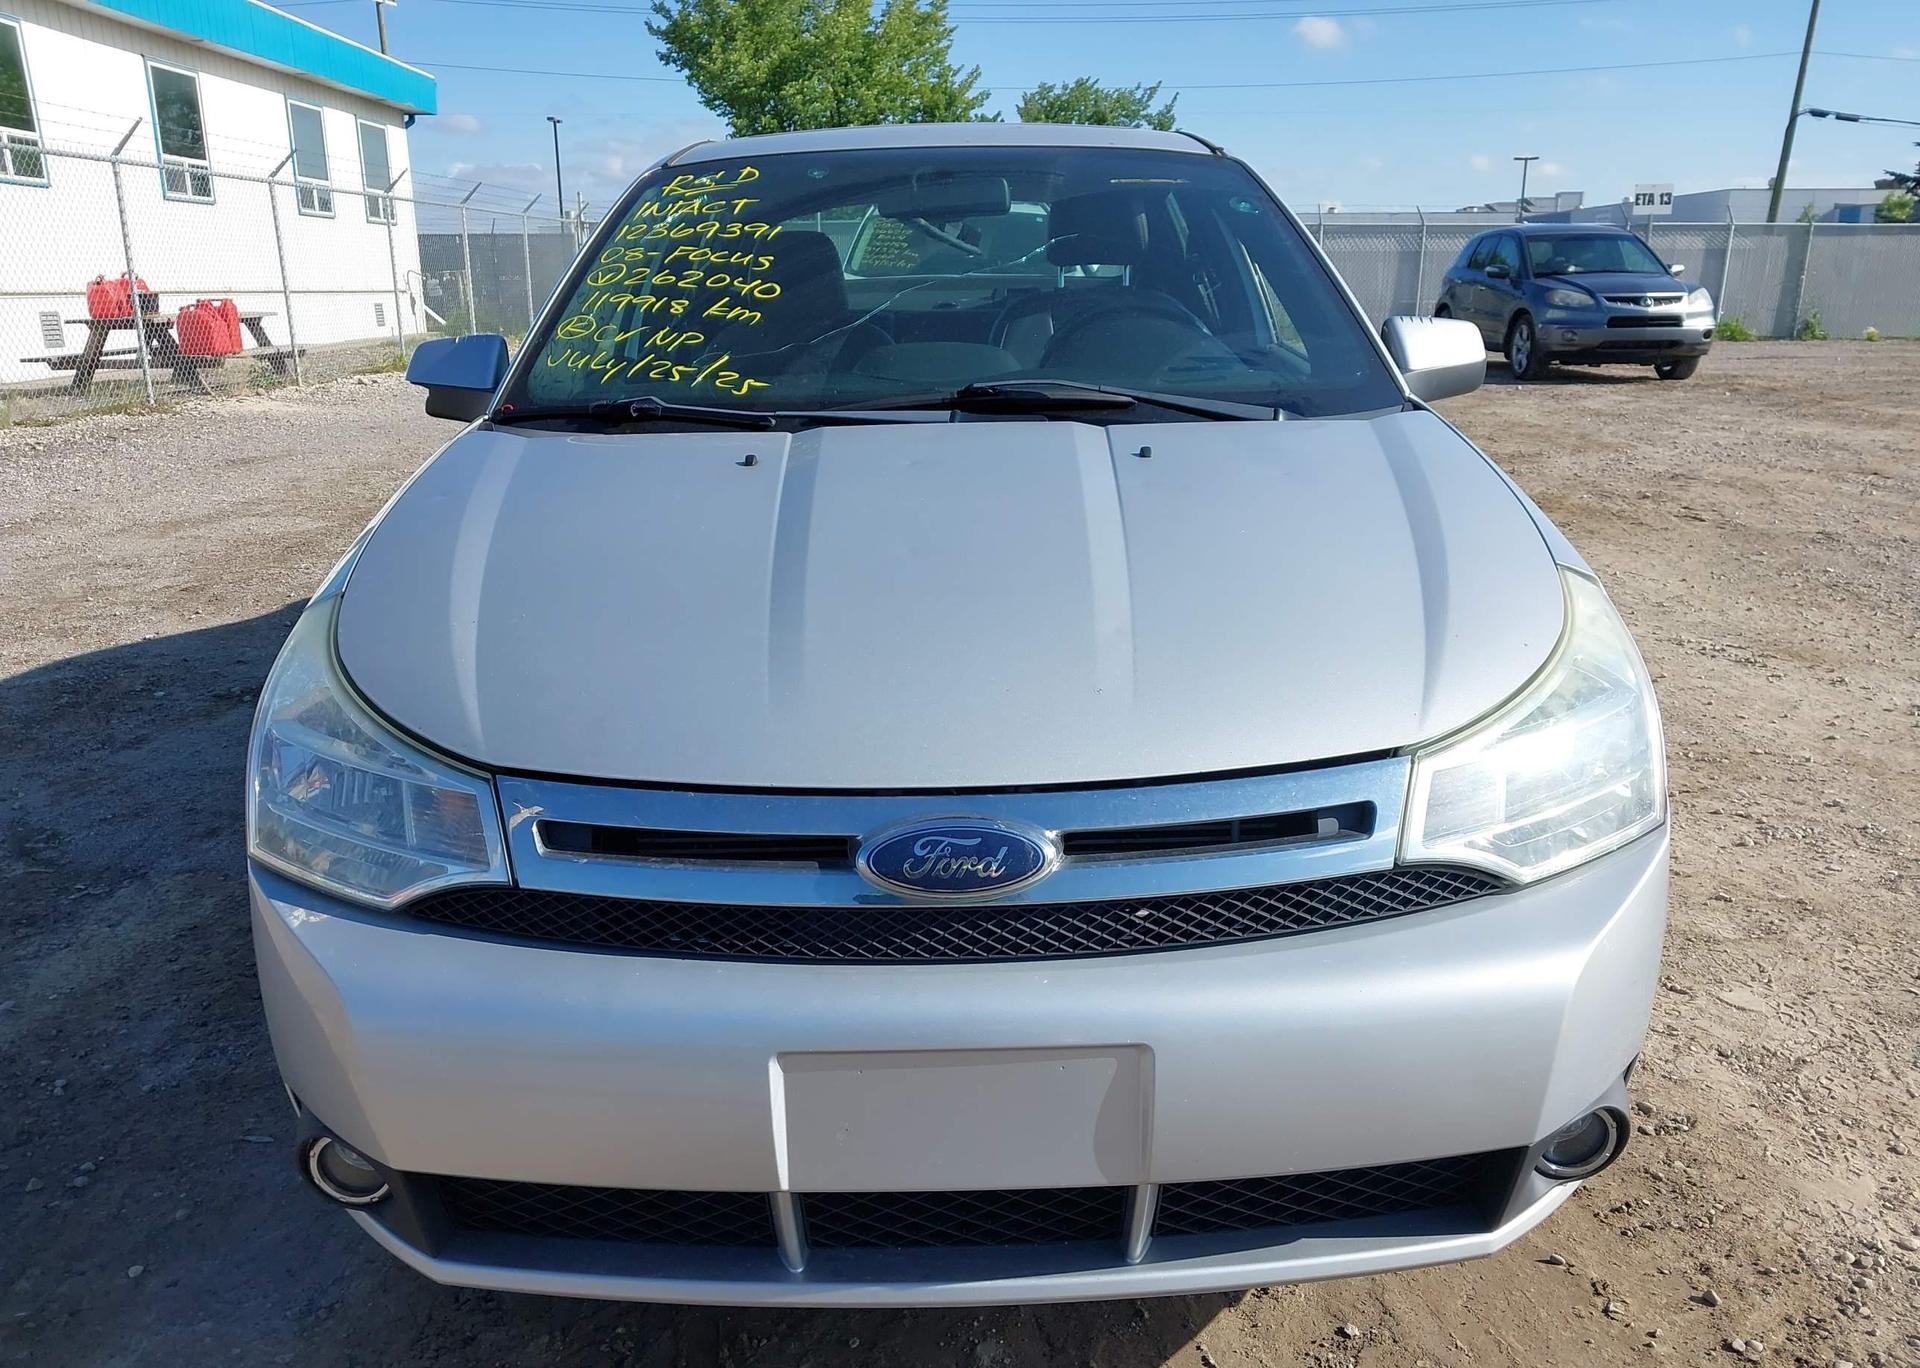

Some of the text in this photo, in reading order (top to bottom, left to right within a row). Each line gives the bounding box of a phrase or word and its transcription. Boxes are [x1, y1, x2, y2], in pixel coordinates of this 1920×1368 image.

[633, 198, 761, 221] INTACT
[1635, 192, 1673, 206] ETA 13
[615, 221, 782, 242] 12369391
[581, 291, 690, 316] 119918
[903, 836, 1008, 879] Ford
